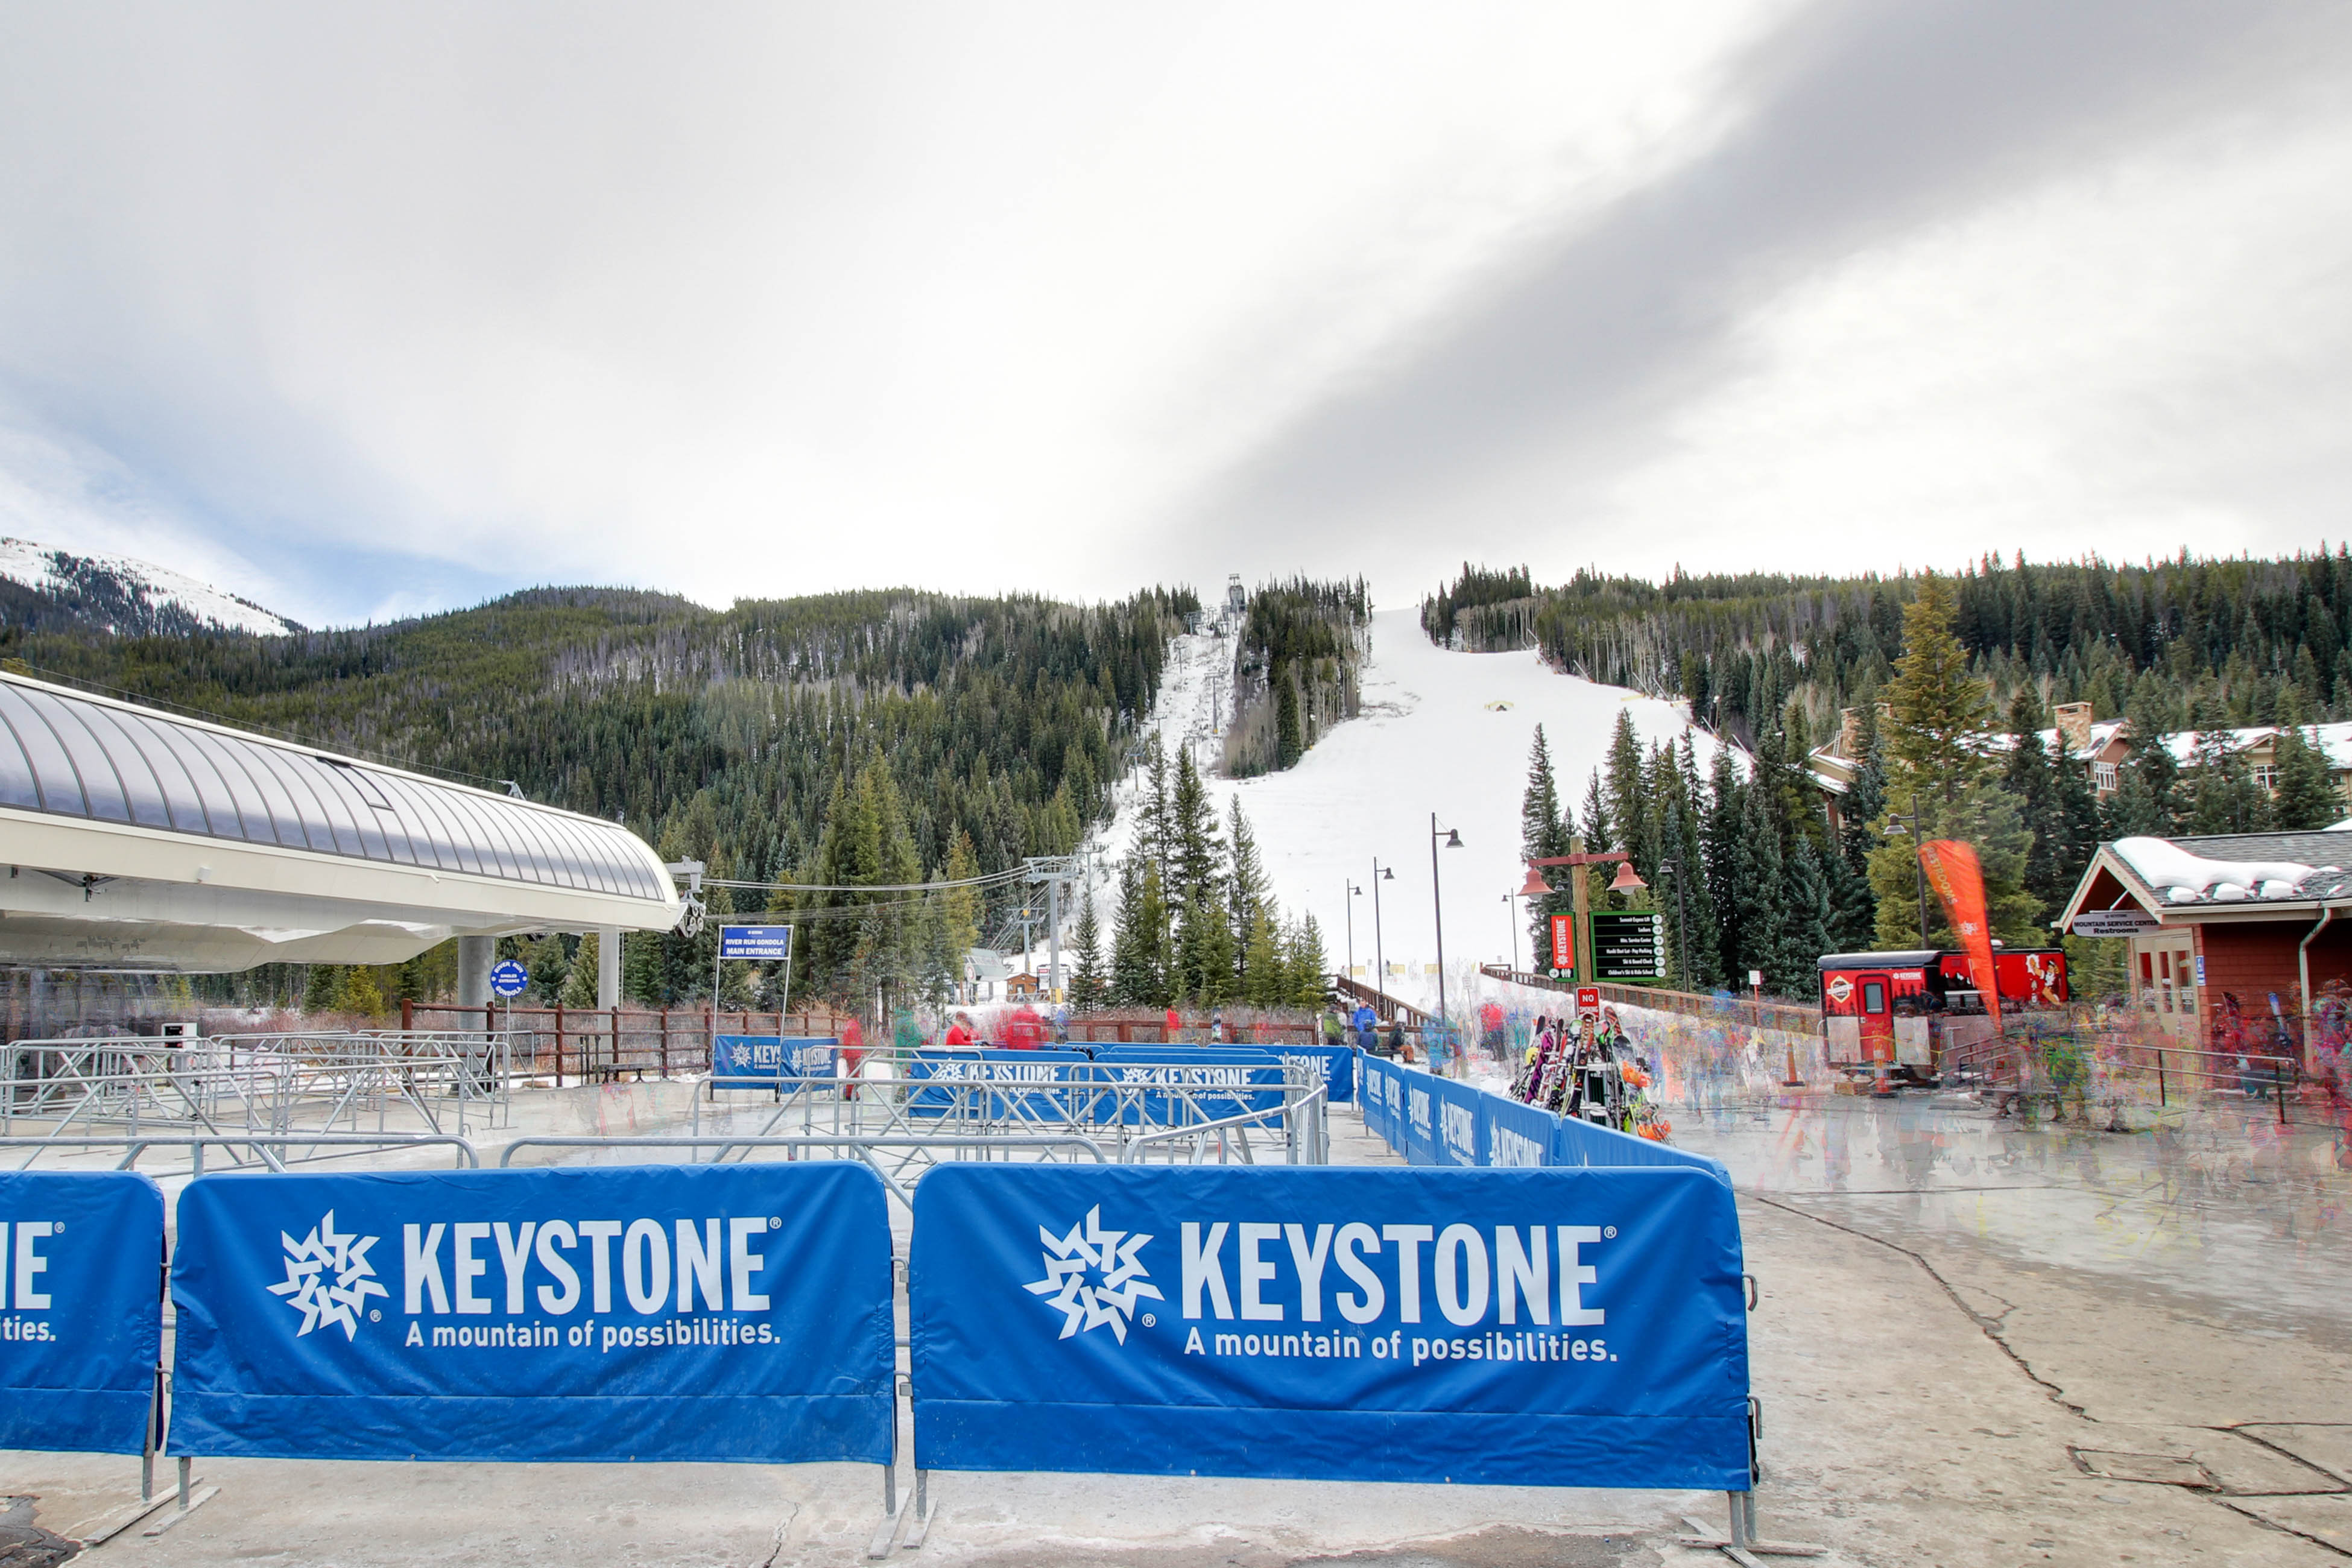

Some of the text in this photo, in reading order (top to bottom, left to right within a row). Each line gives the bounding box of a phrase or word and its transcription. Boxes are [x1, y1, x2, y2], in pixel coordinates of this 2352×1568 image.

[1556, 919, 1567, 953] KEYSTONE
[494, 961, 524, 973] RIVER RUN
[495, 985, 522, 996] GONDOLA
[1155, 1068, 1252, 1092] KEYSTONE
[403, 1217, 771, 1315] KEYSTONE
[1181, 1222, 1605, 1326] KEYSTONE
[0, 1315, 56, 1341] ties.
[405, 1318, 781, 1353] A mountain of possibilities.
[1184, 1327, 1617, 1367] A mountain of possibilities.
